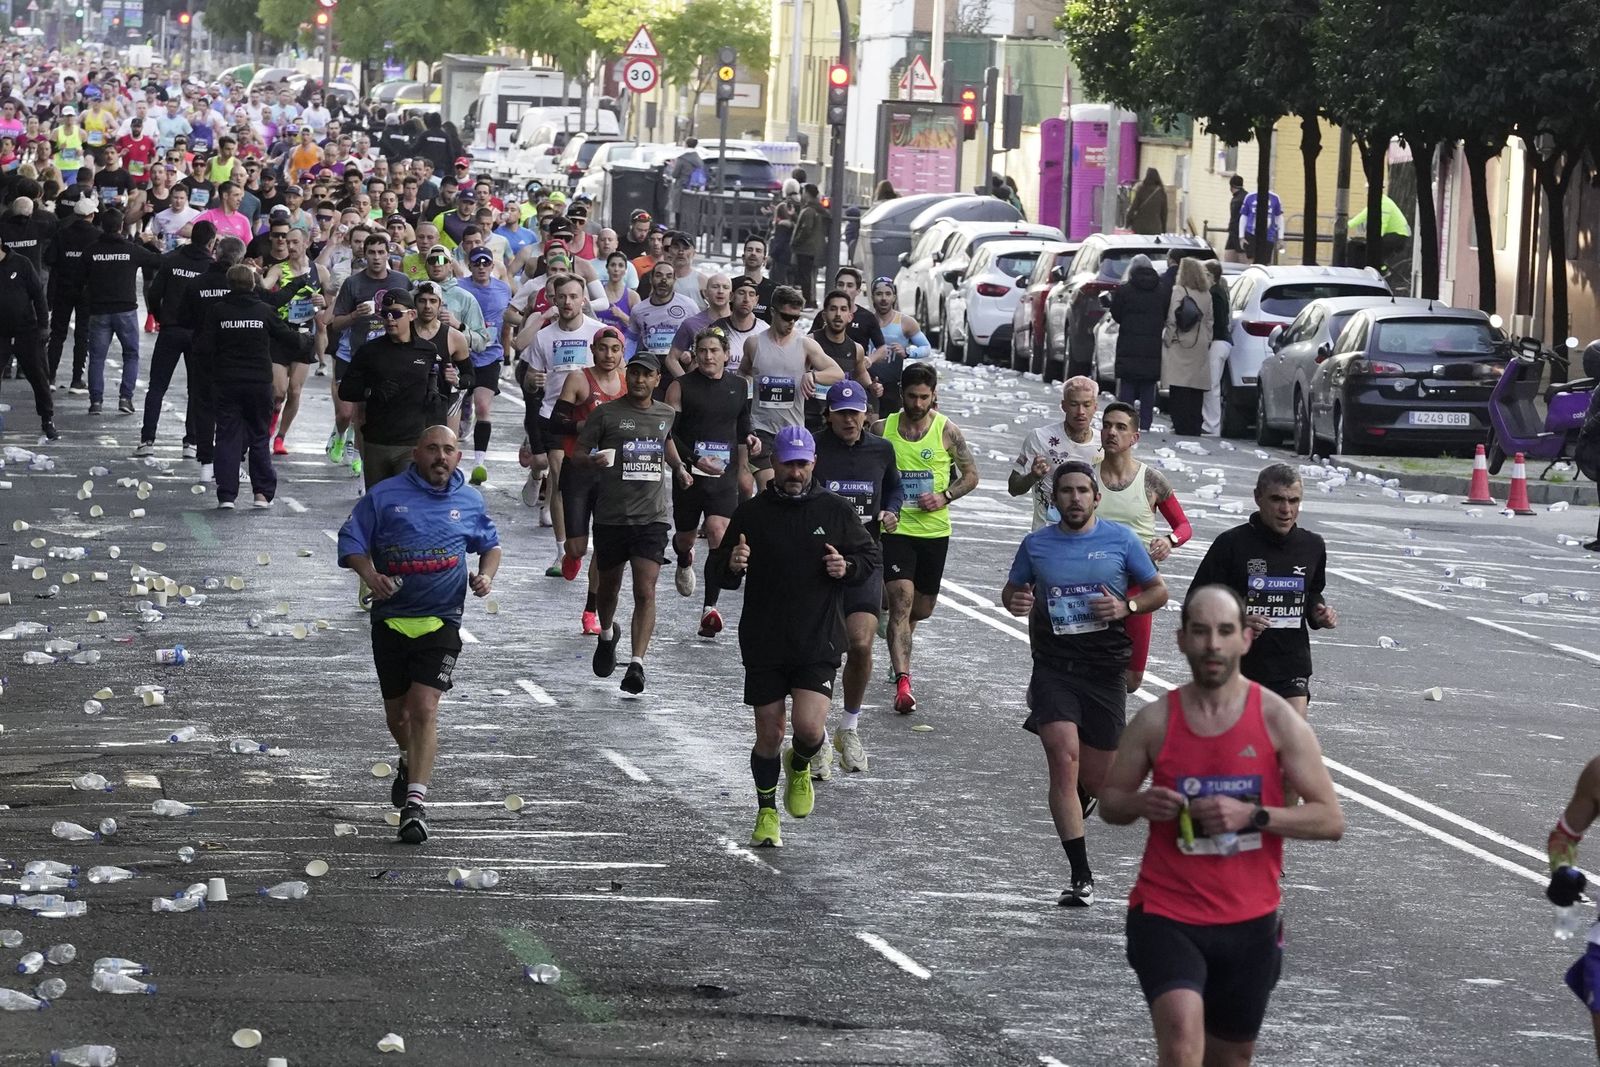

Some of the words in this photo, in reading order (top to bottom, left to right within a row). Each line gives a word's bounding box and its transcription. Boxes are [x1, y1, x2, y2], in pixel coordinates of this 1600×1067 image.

[631, 70, 650, 81] 30
[220, 320, 264, 329] VOLUNTEER
[1417, 413, 1444, 424] 4249
[1446, 414, 1468, 424] GBR
[622, 462, 661, 472] MUSTAPHA
[1065, 584, 1098, 594] ZURICH
[1267, 595, 1284, 603] 5144
[1246, 606, 1270, 616] PEPE
